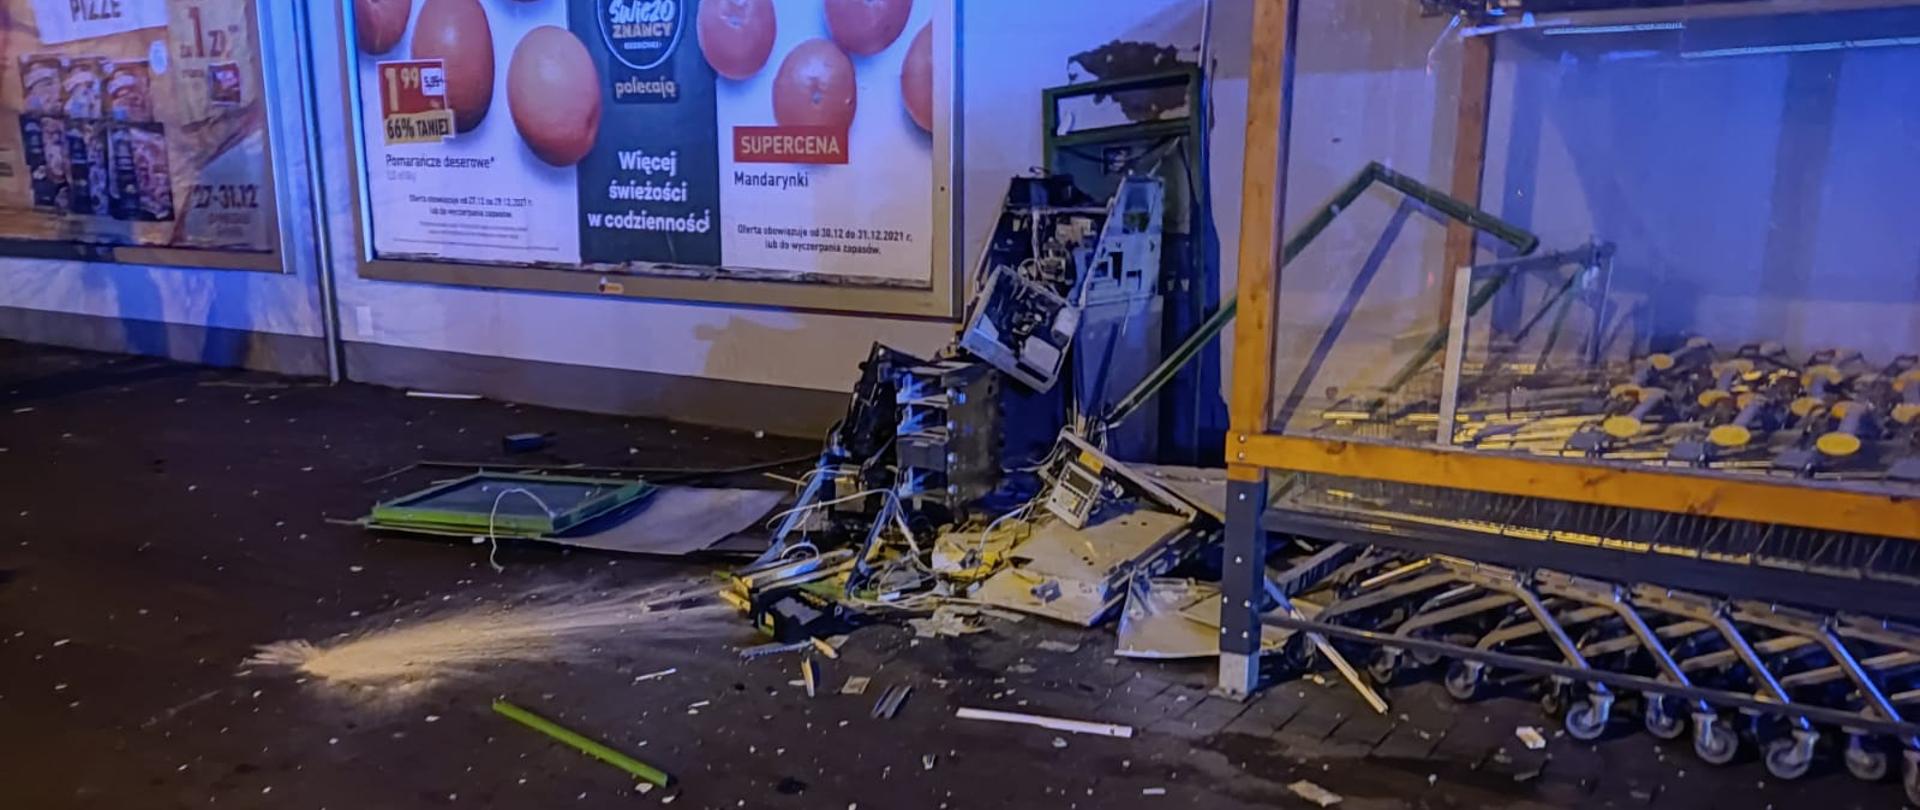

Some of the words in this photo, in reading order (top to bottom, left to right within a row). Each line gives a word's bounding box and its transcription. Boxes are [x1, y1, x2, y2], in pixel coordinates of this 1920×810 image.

[615, 75, 676, 99] polecają
[387, 118, 415, 140] 66%
[417, 119, 449, 136] TANIEJ
[740, 135, 840, 156] SUPERCENA
[385, 153, 441, 168] Pomarańcze
[618, 150, 677, 177] Więcej
[733, 171, 810, 190] Mandarynki
[608, 180, 688, 203] świeżości
[588, 213, 602, 228] w
[604, 209, 711, 234] codzienności
[738, 224, 762, 235] Oferta
[810, 228, 820, 238] od
[845, 229, 855, 239] do
[857, 230, 904, 242] 31.12.2021
[765, 239, 777, 249] lub
[779, 241, 789, 250] do
[791, 241, 841, 253] wyczerpania
